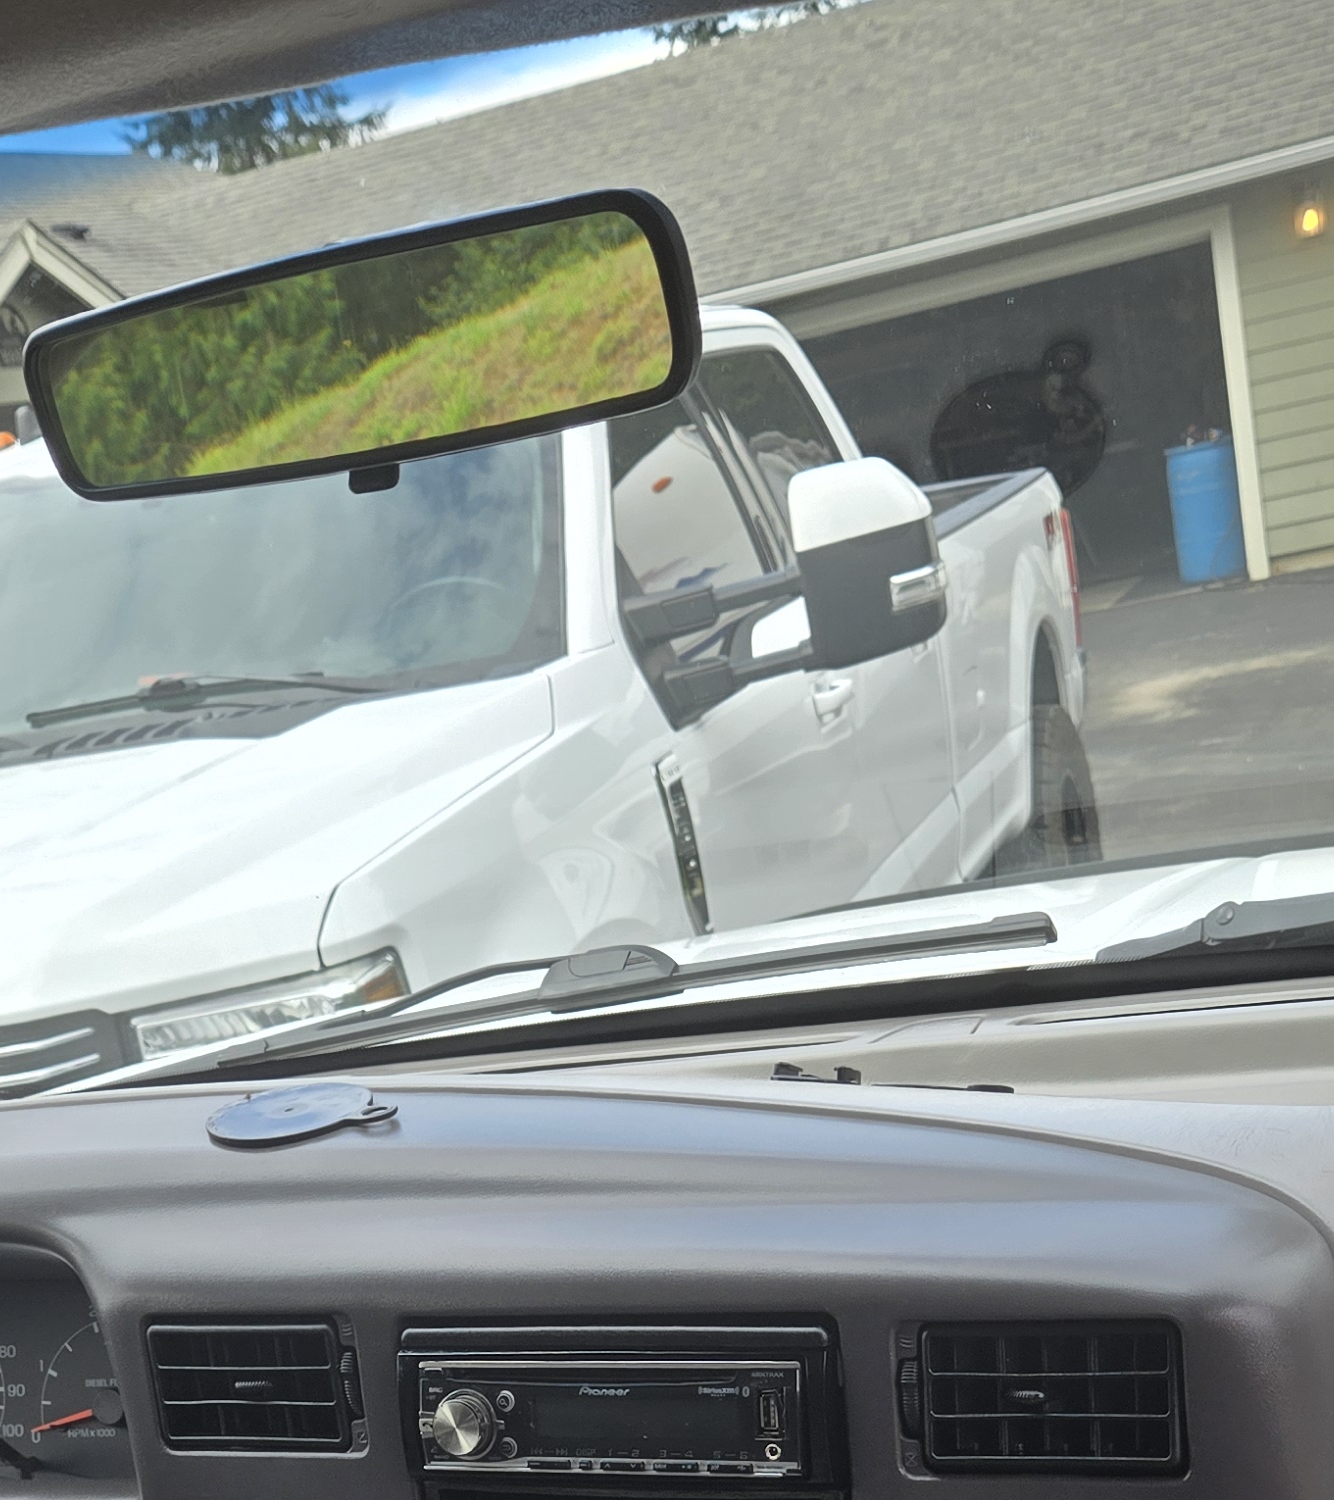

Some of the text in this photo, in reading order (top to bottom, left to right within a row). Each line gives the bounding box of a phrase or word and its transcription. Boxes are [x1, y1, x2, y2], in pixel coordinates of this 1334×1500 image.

[39, 1360, 44, 1372] 1
[8, 1384, 25, 1397] 90
[579, 1386, 630, 1397] Pioneer
[2, 1424, 24, 1437] 100
[31, 1430, 41, 1443] 0
[68, 1429, 89, 1438] RPM
[96, 1429, 116, 1437] 1000
[576, 1448, 597, 1457] DISP
